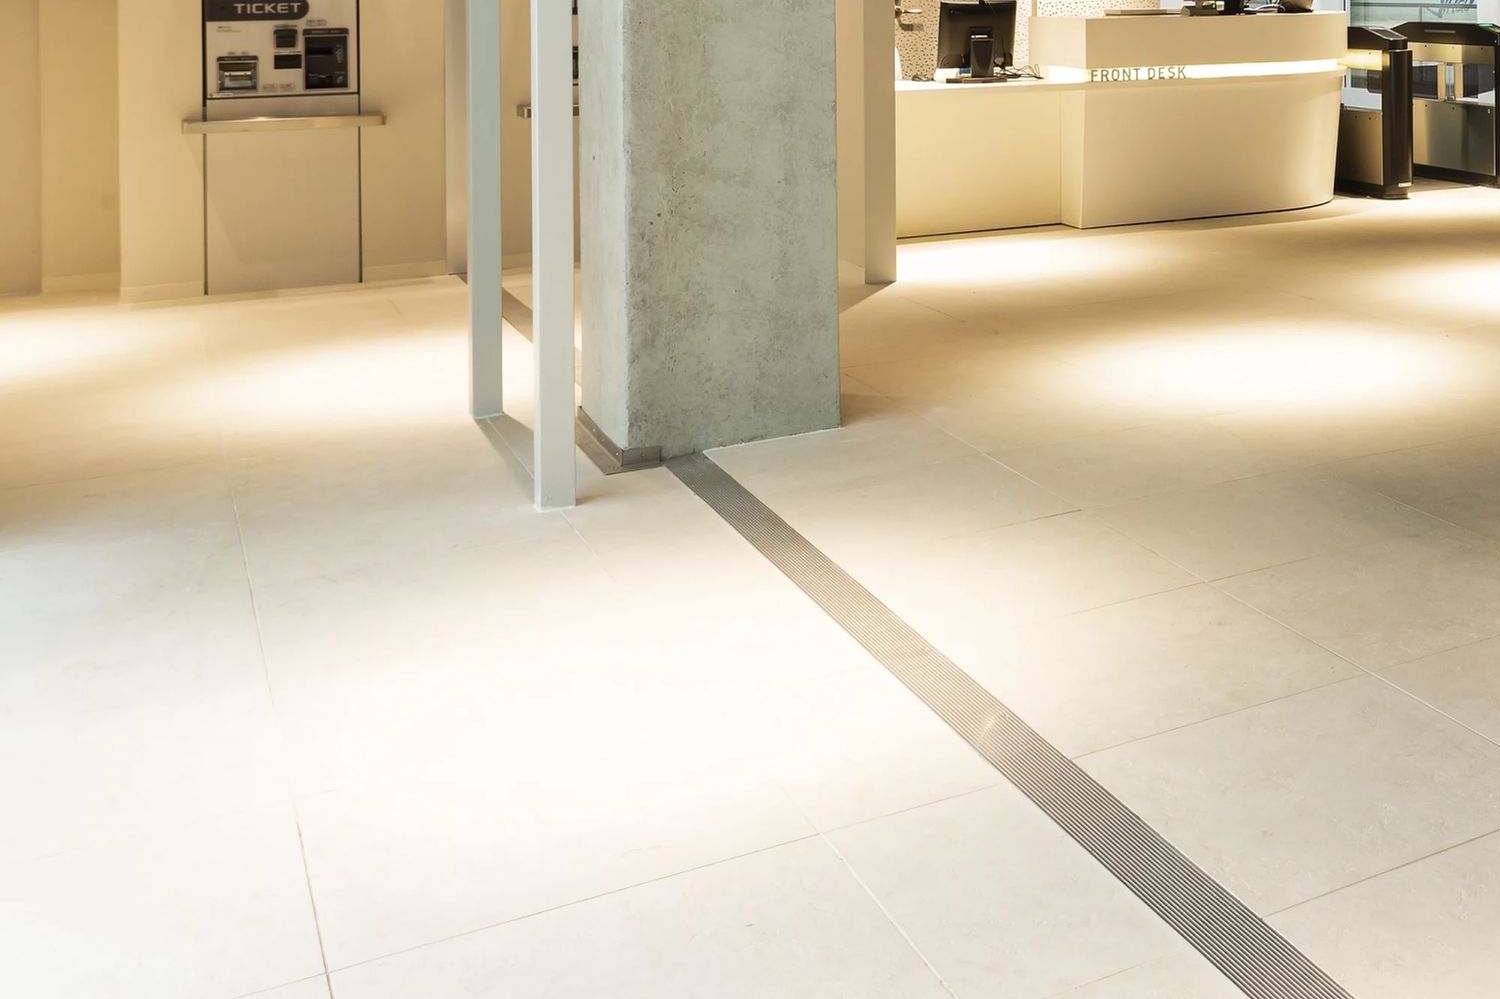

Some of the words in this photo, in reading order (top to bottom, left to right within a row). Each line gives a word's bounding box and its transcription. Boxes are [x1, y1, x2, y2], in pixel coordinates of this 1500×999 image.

[233, 2, 301, 14] TICKET
[1090, 68, 1141, 83] FRONT
[1147, 65, 1187, 81] DESK
